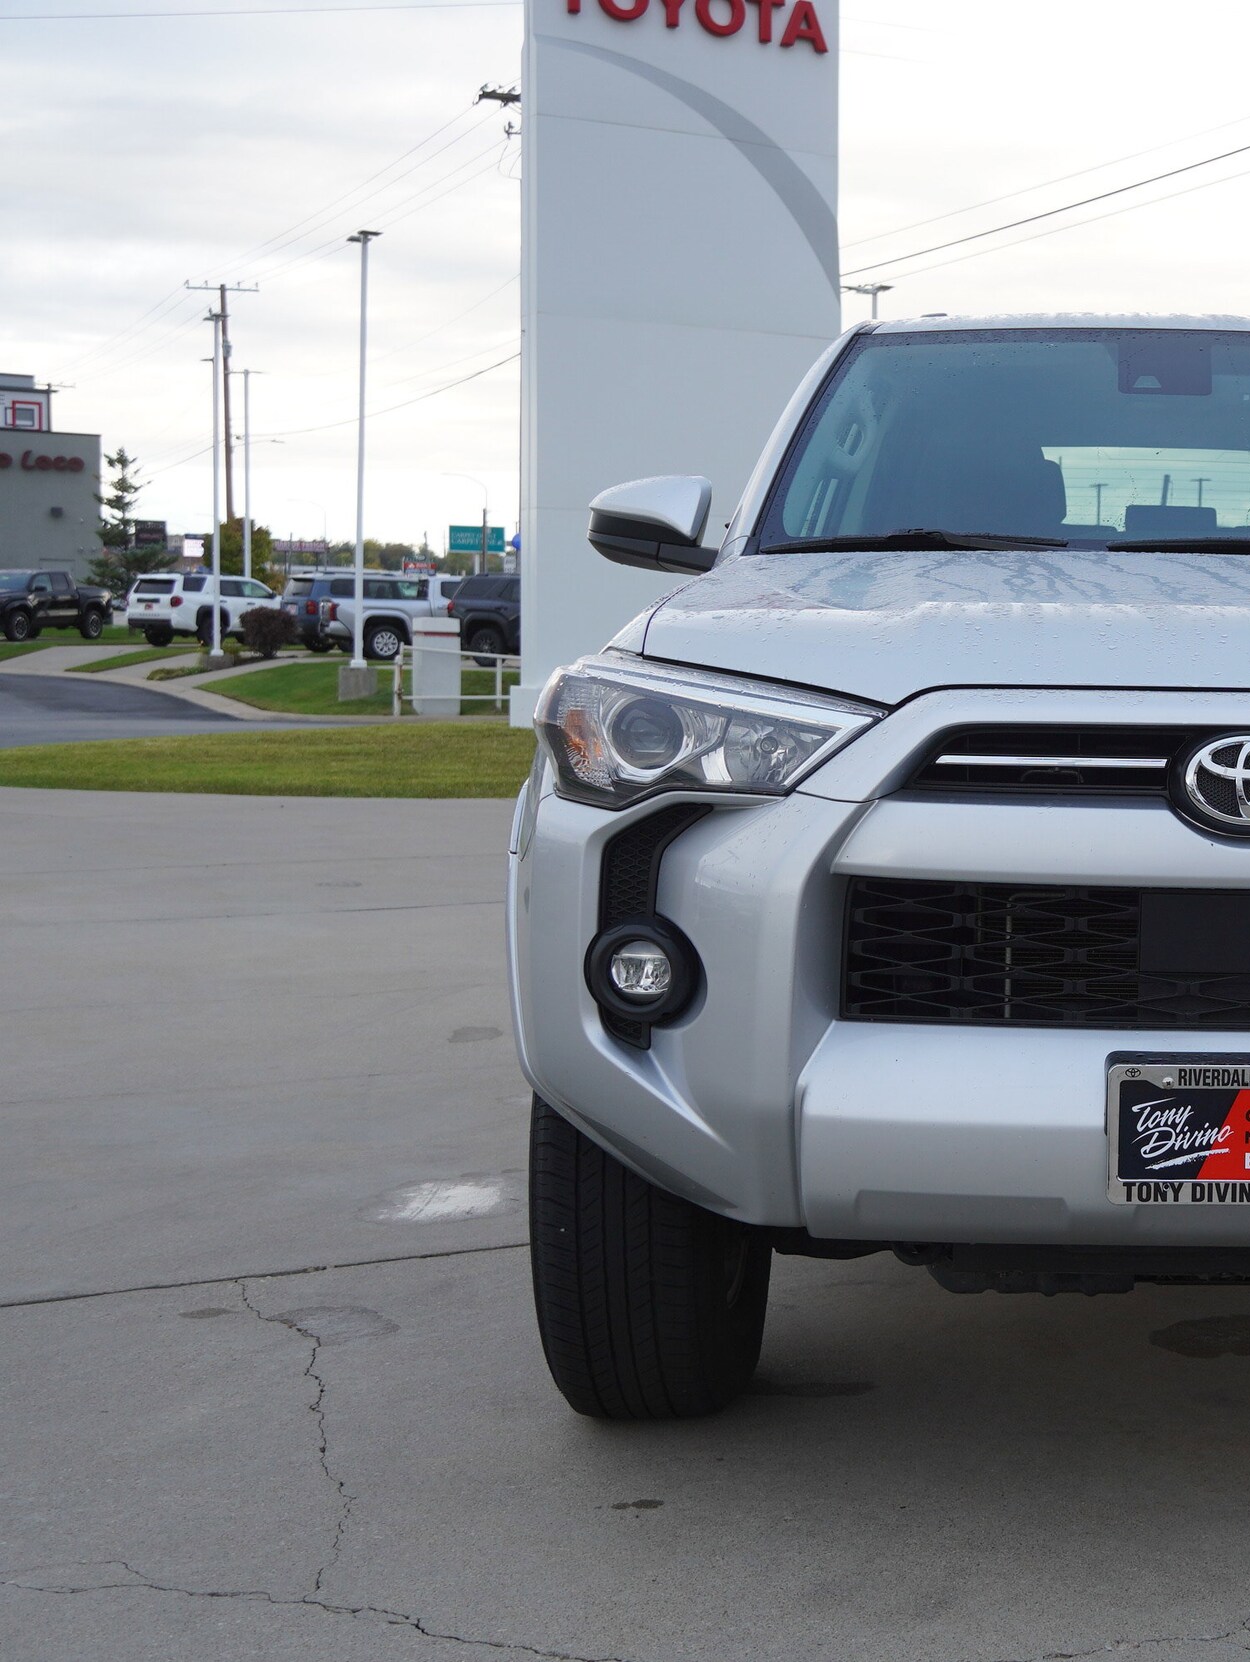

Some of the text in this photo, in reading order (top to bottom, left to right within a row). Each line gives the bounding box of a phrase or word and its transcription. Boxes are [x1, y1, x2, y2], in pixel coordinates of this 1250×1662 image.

[21, 449, 85, 472] Loco
[1131, 1097, 1194, 1133] Tony
[1131, 1122, 1235, 1158] Divino
[1122, 1182, 1189, 1203] TONY
